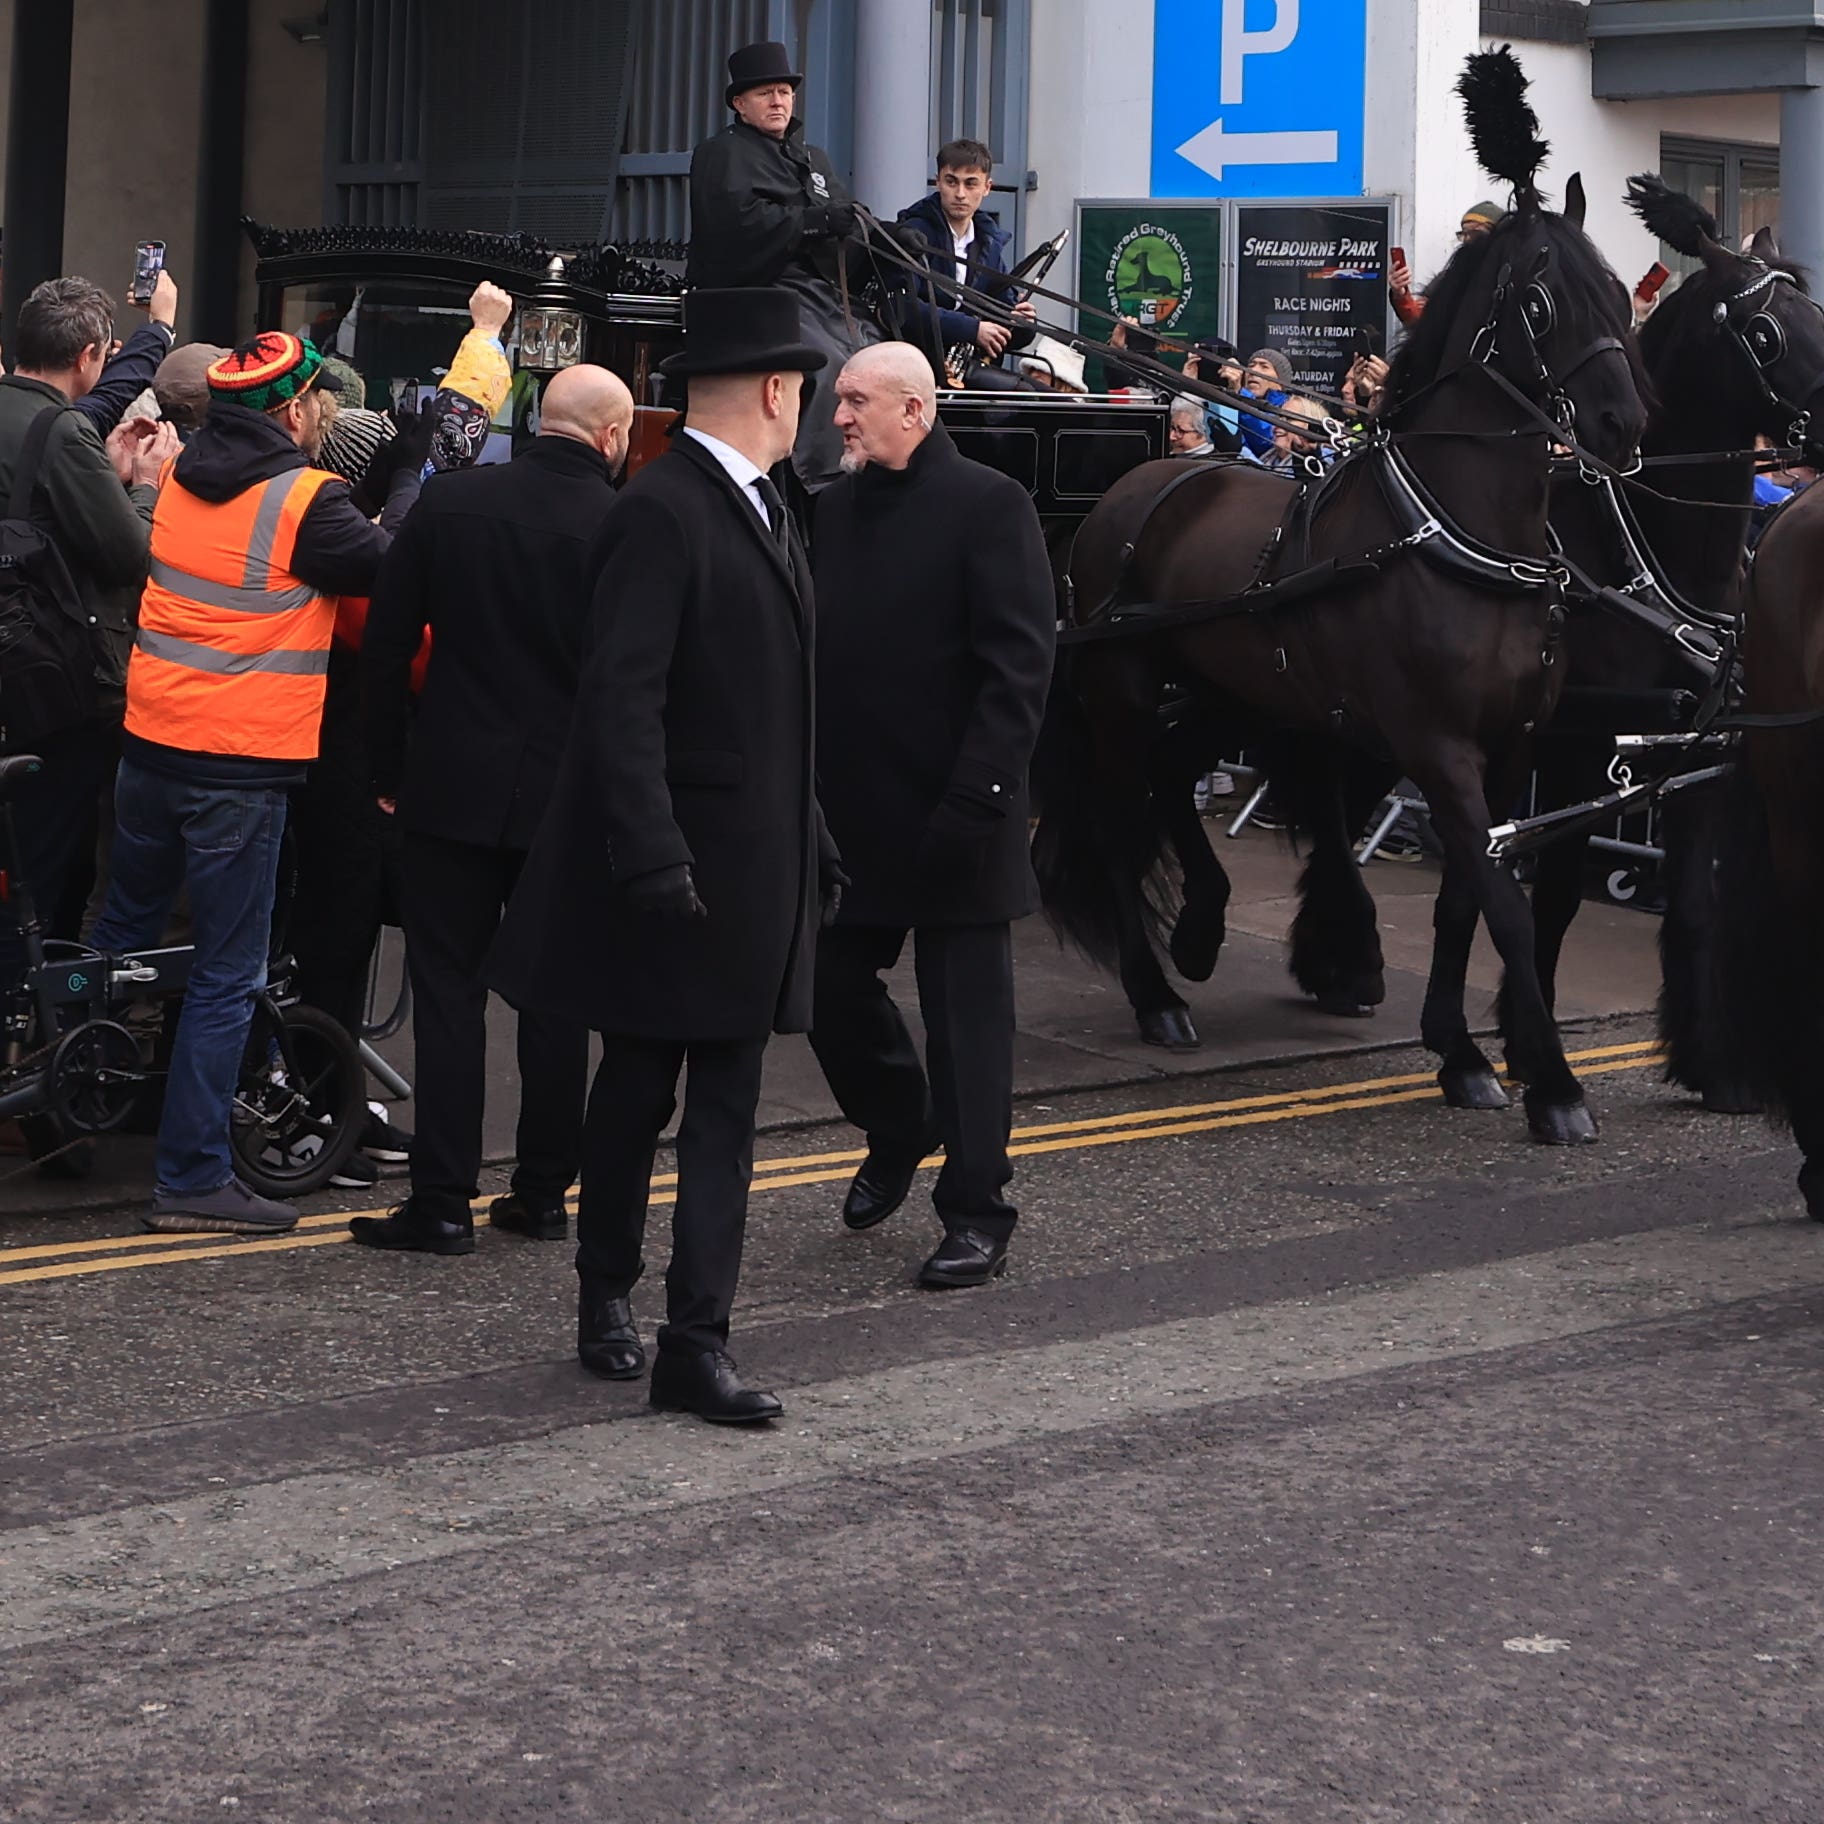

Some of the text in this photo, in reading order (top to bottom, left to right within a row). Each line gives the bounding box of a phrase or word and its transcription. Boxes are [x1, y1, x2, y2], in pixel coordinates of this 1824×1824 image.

[1243, 237, 1379, 257] SHELBOURNE PARK
[1256, 259, 1325, 267] GREYHOUND STADIUM
[1140, 223, 1192, 283] Greyhound
[1167, 287, 1193, 328] Trust
[1274, 297, 1351, 312] RACE NIGHTS
[1268, 325, 1356, 337] THURSDAY & FRIDAY
[1291, 371, 1334, 382] ATURDAY
